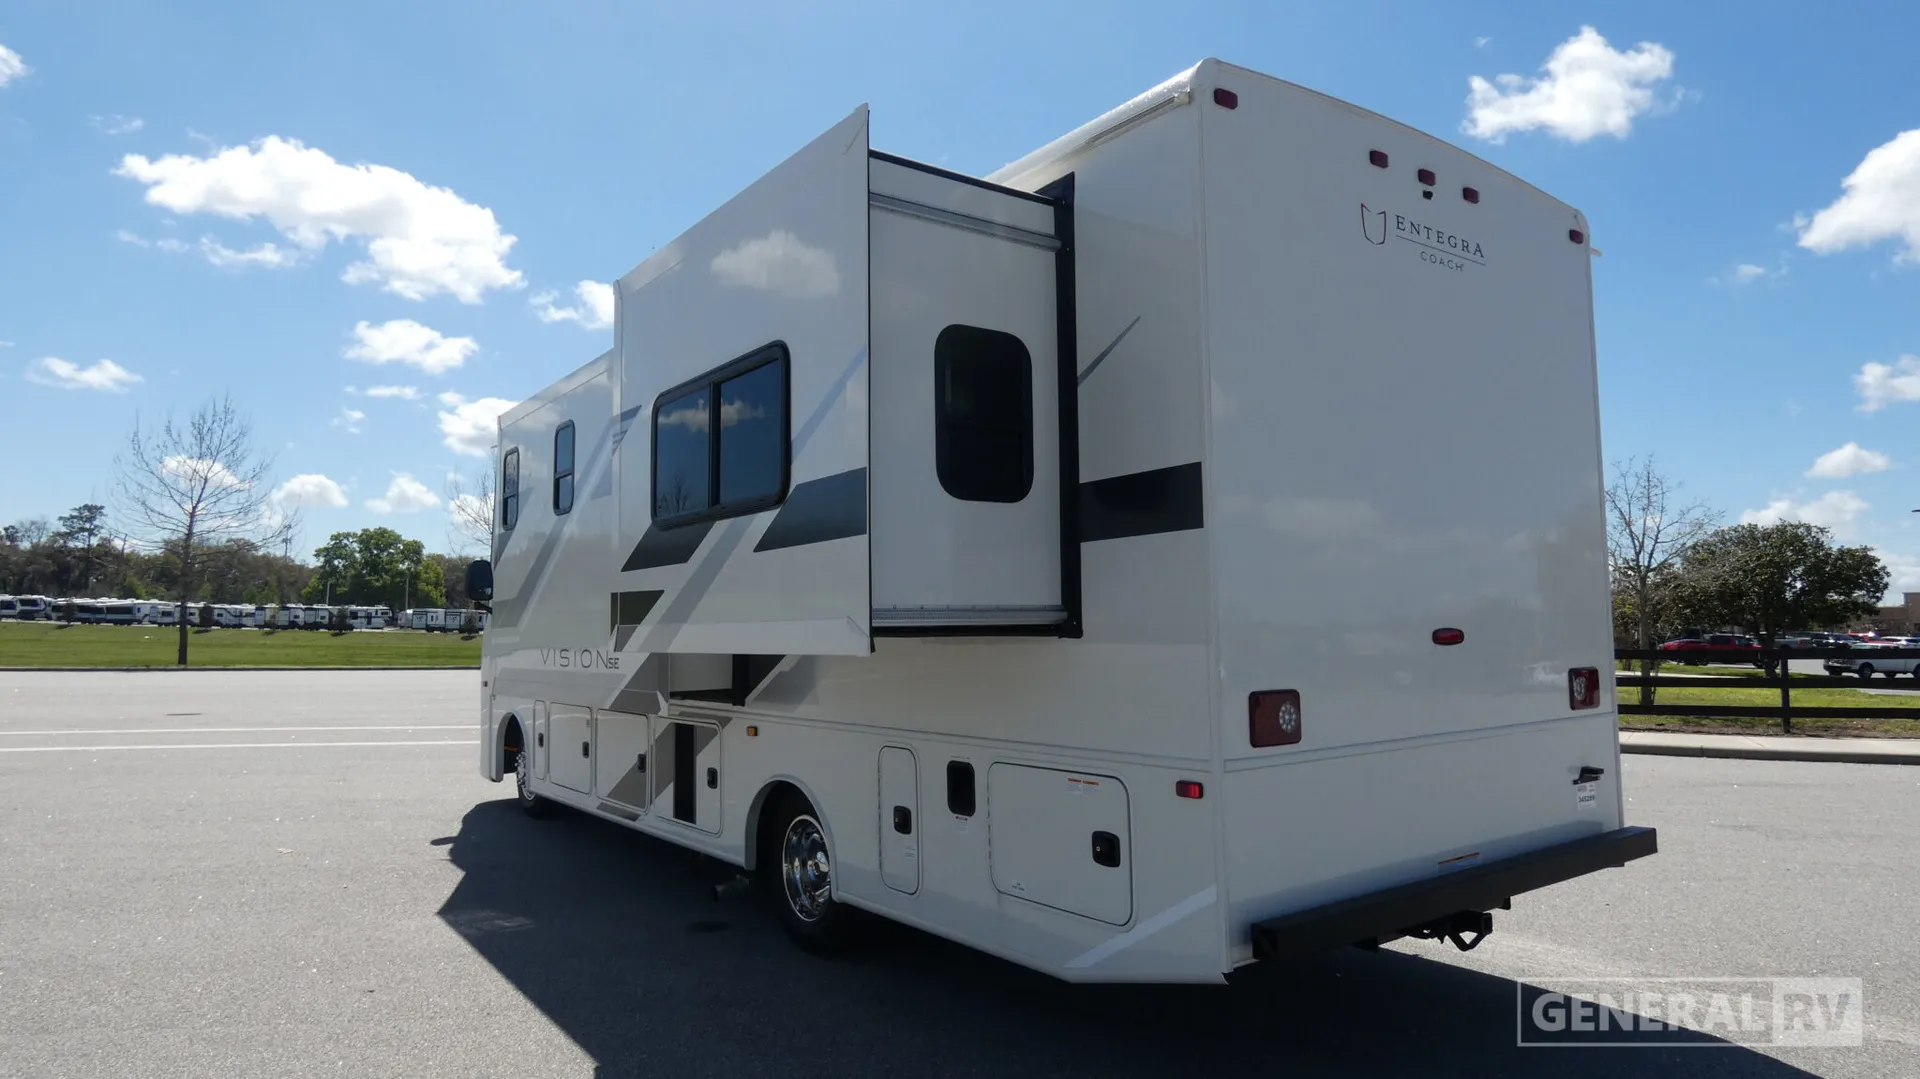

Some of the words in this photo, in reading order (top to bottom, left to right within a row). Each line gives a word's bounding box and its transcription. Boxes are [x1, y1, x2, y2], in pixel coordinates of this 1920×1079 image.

[1395, 214, 1485, 259] ENTEGRA
[1420, 251, 1464, 272] COACH
[540, 648, 609, 670] VISION
